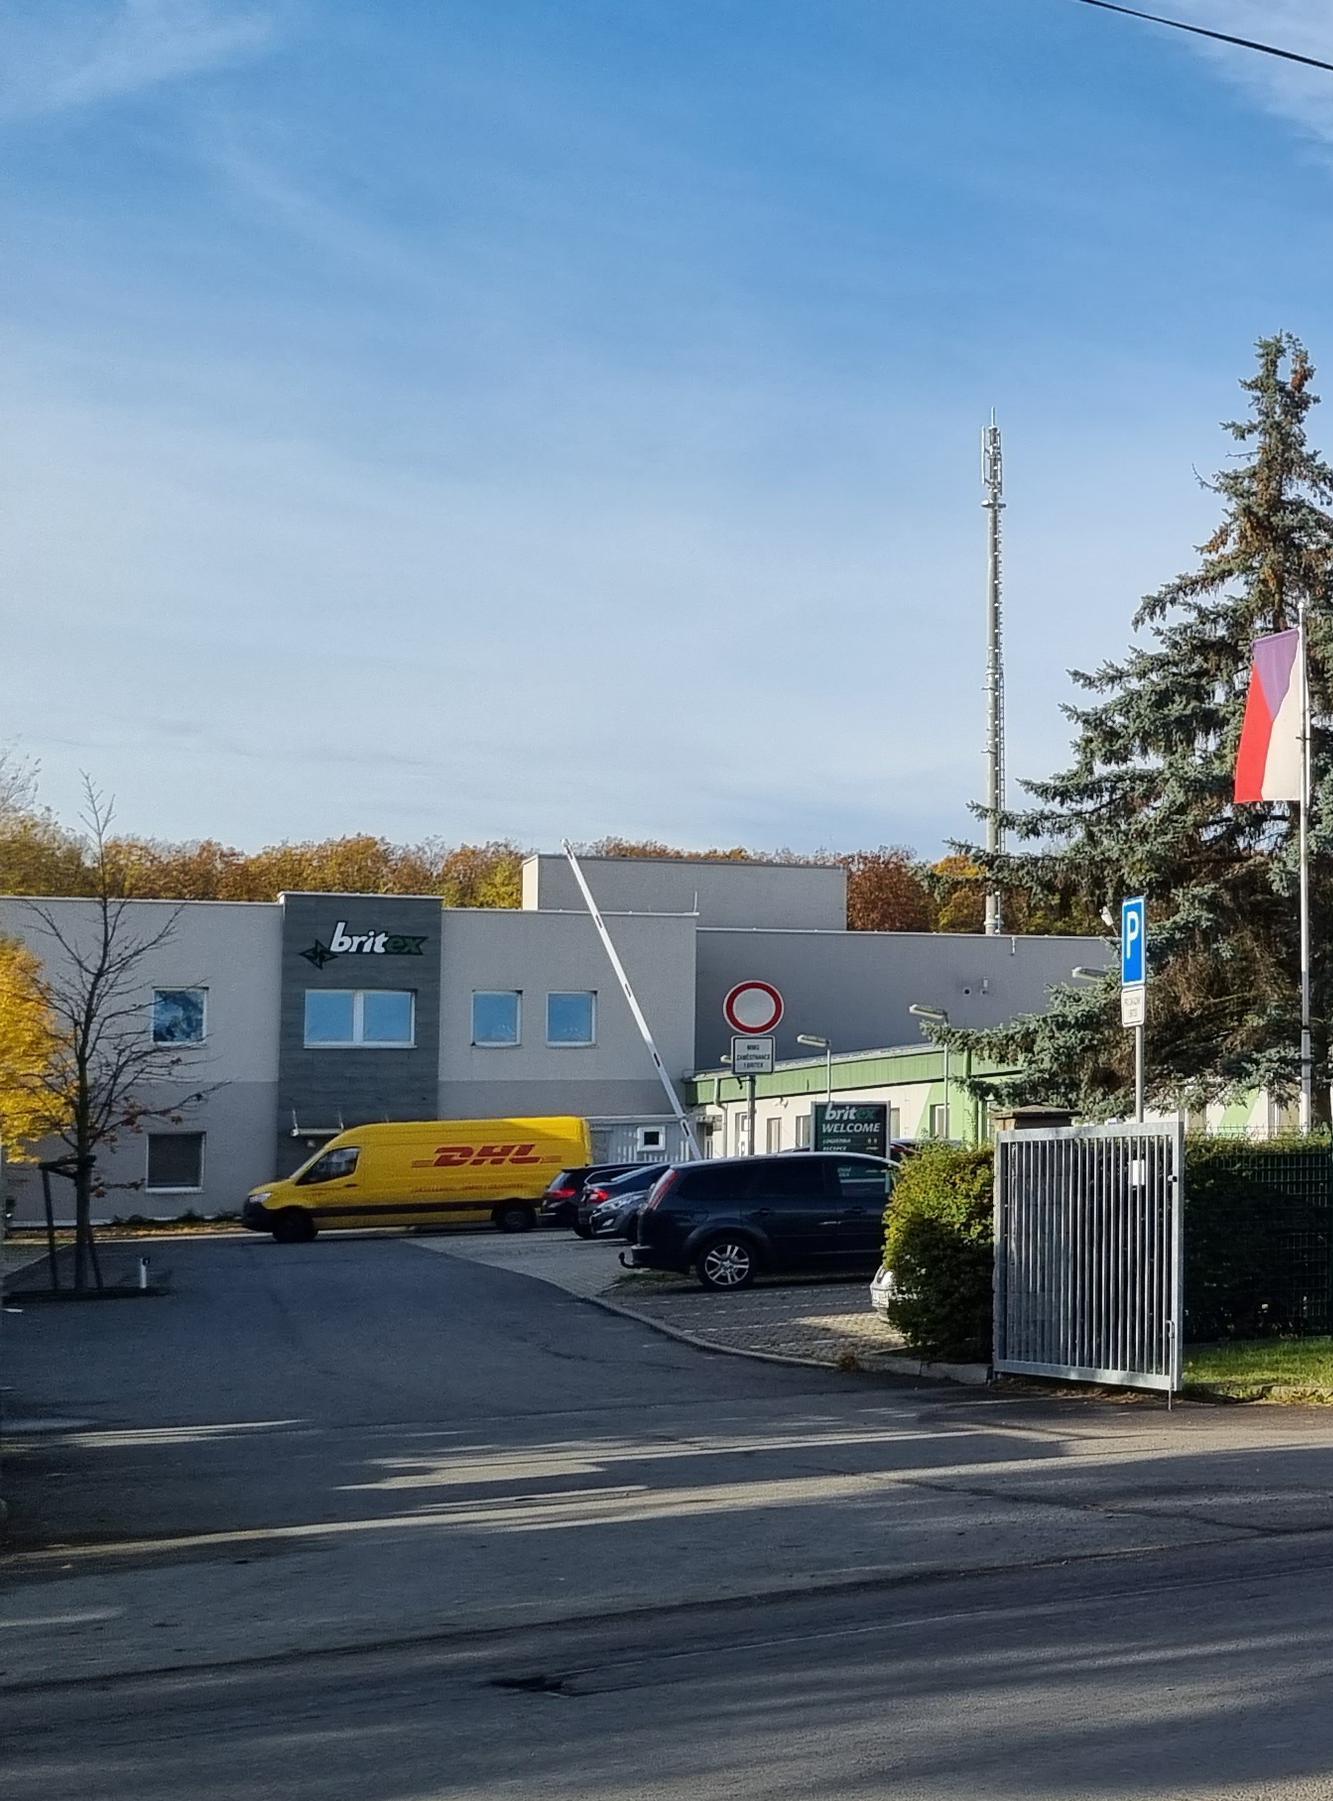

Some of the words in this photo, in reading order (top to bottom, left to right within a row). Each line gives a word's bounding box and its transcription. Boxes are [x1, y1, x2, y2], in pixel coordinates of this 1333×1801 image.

[330, 921, 428, 954] britex
[1126, 911, 1140, 960] P
[825, 1102, 875, 1120] britex
[822, 1122, 881, 1133] WELCOME
[434, 1143, 541, 1167] DHL
